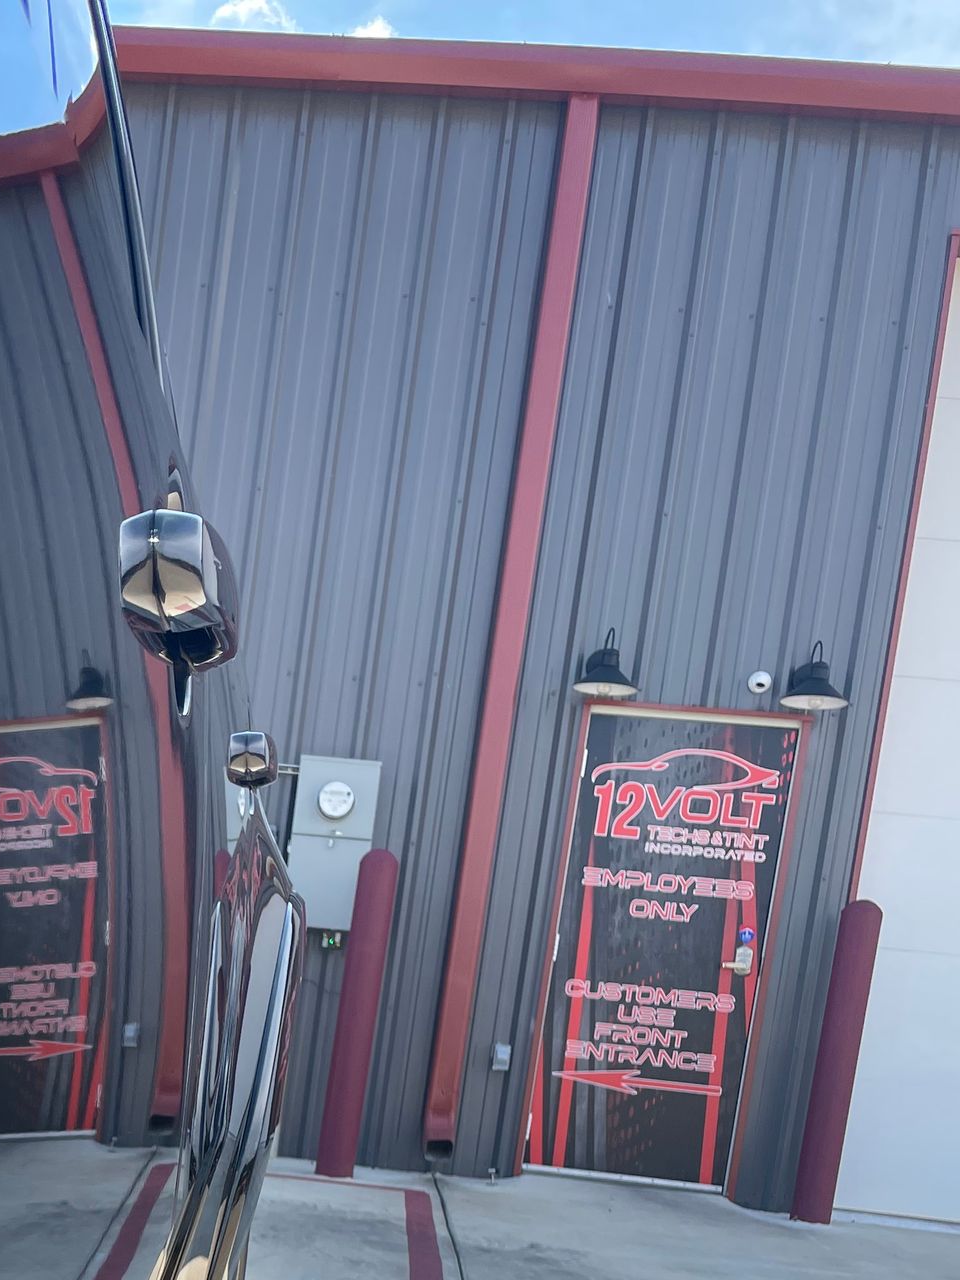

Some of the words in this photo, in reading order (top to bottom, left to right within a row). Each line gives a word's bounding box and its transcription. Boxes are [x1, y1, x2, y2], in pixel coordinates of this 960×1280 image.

[594, 780, 776, 839] 12VOLT
[644, 842, 766, 862] INCORPORATED
[581, 866, 754, 900] EMPLOYEES
[629, 899, 699, 923] ONLY
[565, 978, 736, 1013] CUSTOMERS
[617, 1004, 676, 1028] USE
[594, 1021, 688, 1048] FRONT
[565, 1039, 716, 1073] ENTRANCE
